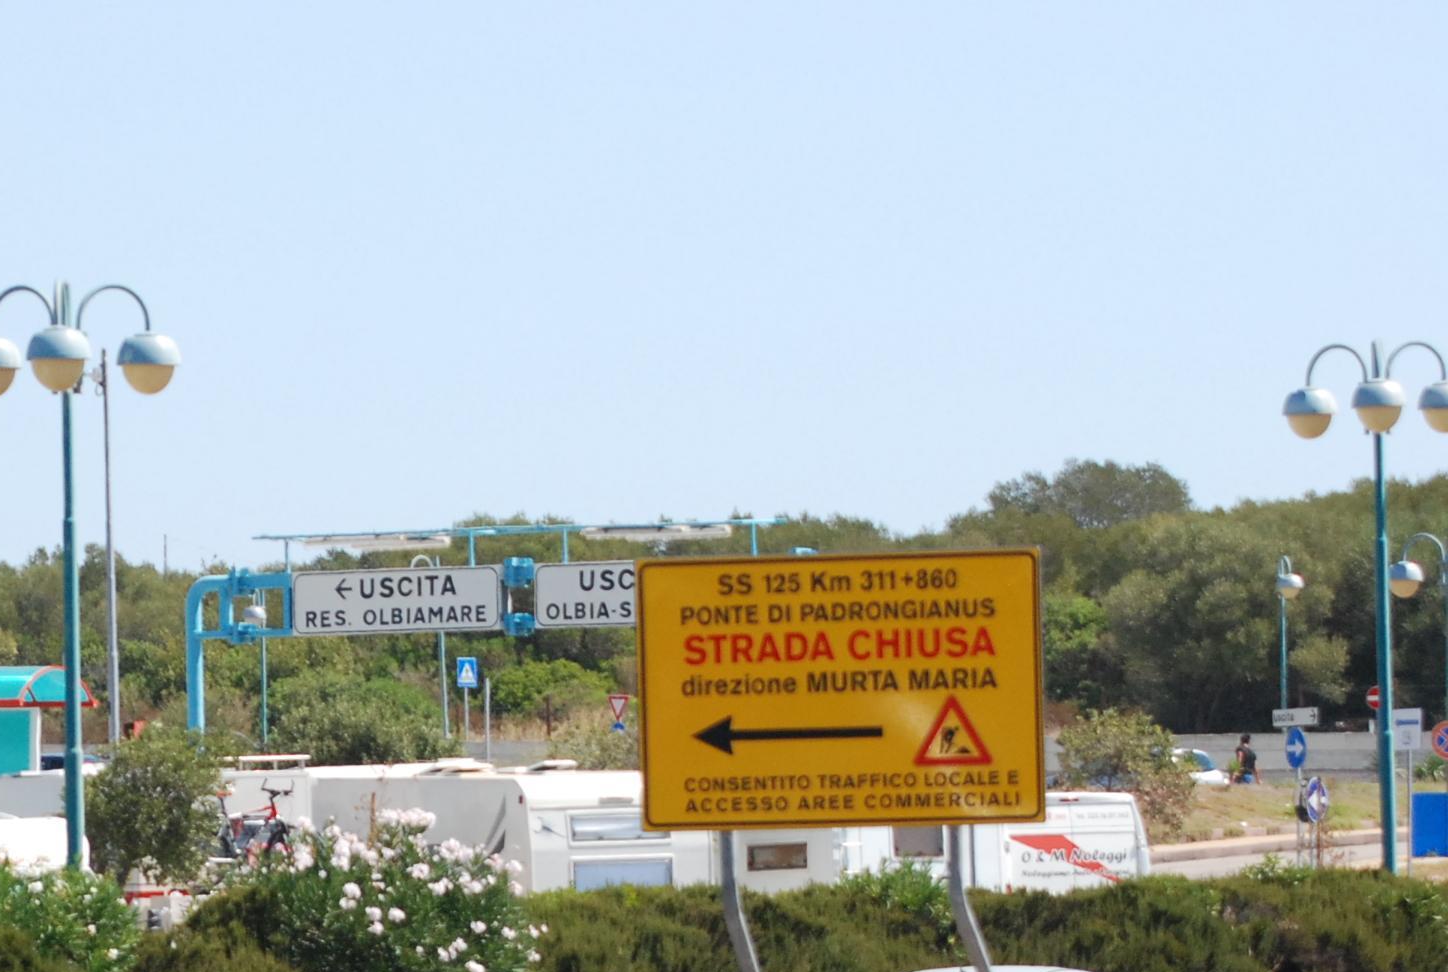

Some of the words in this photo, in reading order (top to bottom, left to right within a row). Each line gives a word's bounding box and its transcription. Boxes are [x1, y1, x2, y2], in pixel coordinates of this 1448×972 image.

[359, 575, 457, 599] USCITA
[579, 569, 635, 591] USC
[718, 573, 753, 595] SS
[764, 573, 800, 594] 125
[810, 571, 850, 593] Km
[860, 569, 957, 590] 311+860
[306, 610, 352, 628] RES.
[363, 604, 487, 626] OLBIAMARE
[546, 601, 633, 620] OLBIA-S
[680, 604, 759, 625] PONTE
[769, 604, 792, 624] DI
[801, 598, 996, 622] PADRONGIANUS
[683, 633, 834, 666] STRADA
[847, 626, 996, 660] CHIUSA
[681, 673, 797, 697] direzione
[807, 670, 899, 694] MURTA
[909, 668, 998, 691] MARIA
[684, 775, 811, 793] CONSENTITO
[817, 772, 917, 790] TRAFFICO
[924, 770, 1000, 788] LOCALE
[1008, 769, 1020, 786] E
[685, 796, 789, 815] ACCESSO
[797, 794, 855, 811] AREE
[864, 791, 1021, 810] COMMERCIALI
